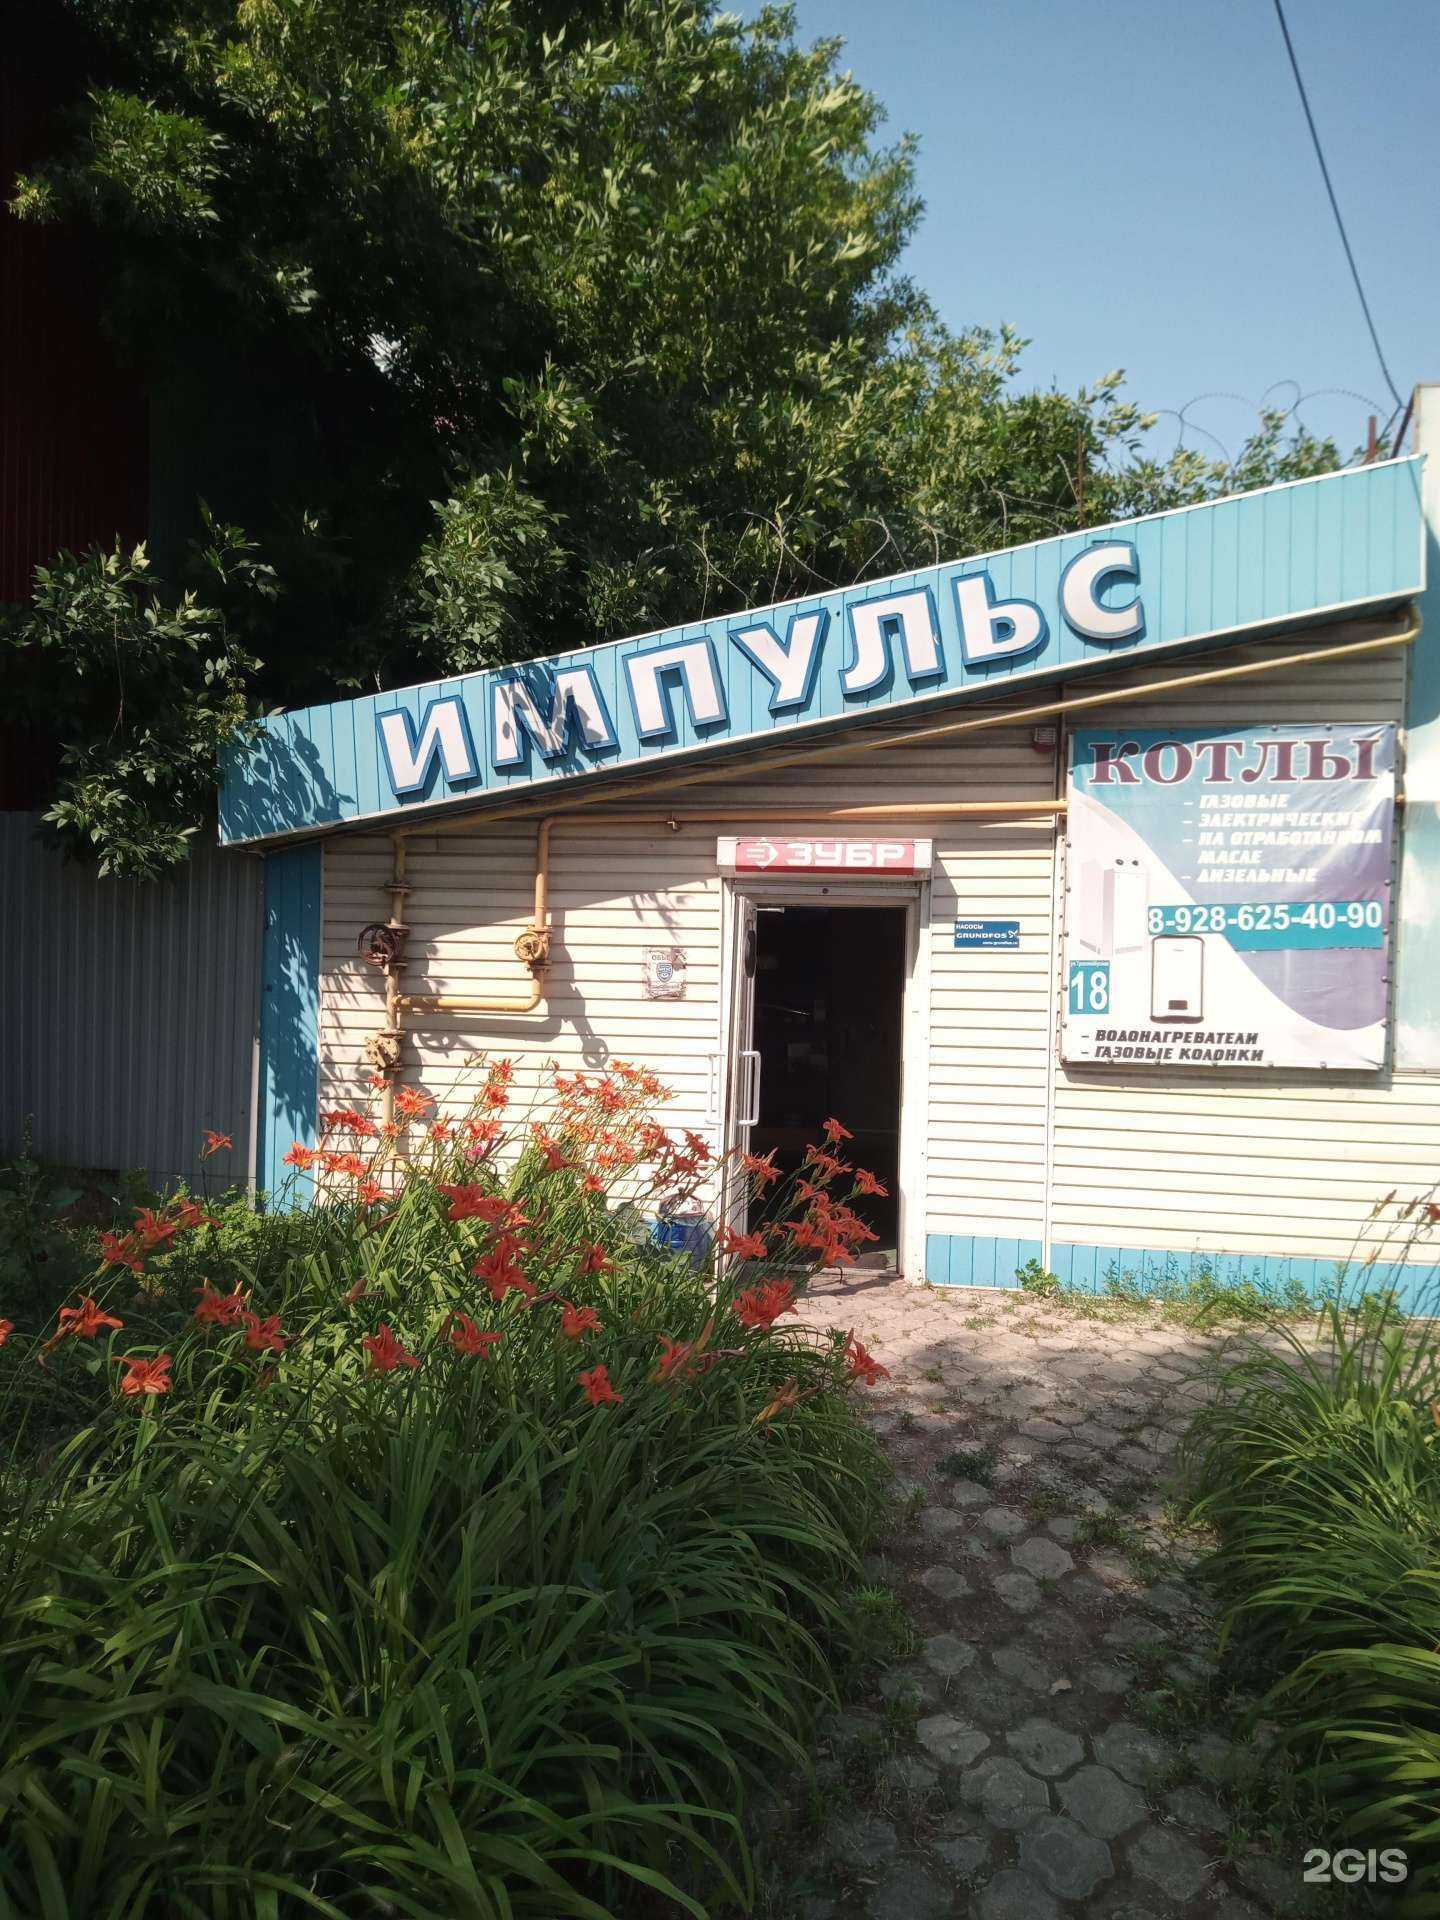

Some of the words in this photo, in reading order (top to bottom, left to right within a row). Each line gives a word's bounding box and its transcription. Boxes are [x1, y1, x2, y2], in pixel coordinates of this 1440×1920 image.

[376, 541, 1147, 794] ИМПУЛЬС
[1088, 739, 1381, 785] КОТЛЫ
[1199, 794, 1290, 809] ГАЗОВЫЕ
[1198, 811, 1364, 827] ЭЛЕКТРИЧЕСКИЕ
[1198, 831, 1224, 846] НА
[1230, 829, 1383, 846] ОТРАБОТАННОМ
[784, 842, 905, 867] ЗУБР
[1197, 850, 1263, 865] МАСЛЕ
[1196, 868, 1319, 883] ДИЗЕЛЬНЫЕ
[1148, 904, 1382, 934] 8-928-625-40-90
[1071, 970, 1108, 1011] 18
[1095, 1029, 1259, 1045] ВОДОНАГРЕВАТЕЛИ
[1094, 1045, 1174, 1060] ГАЗОВЫЕ
[1178, 1048, 1265, 1062] КОЛОНКИ
